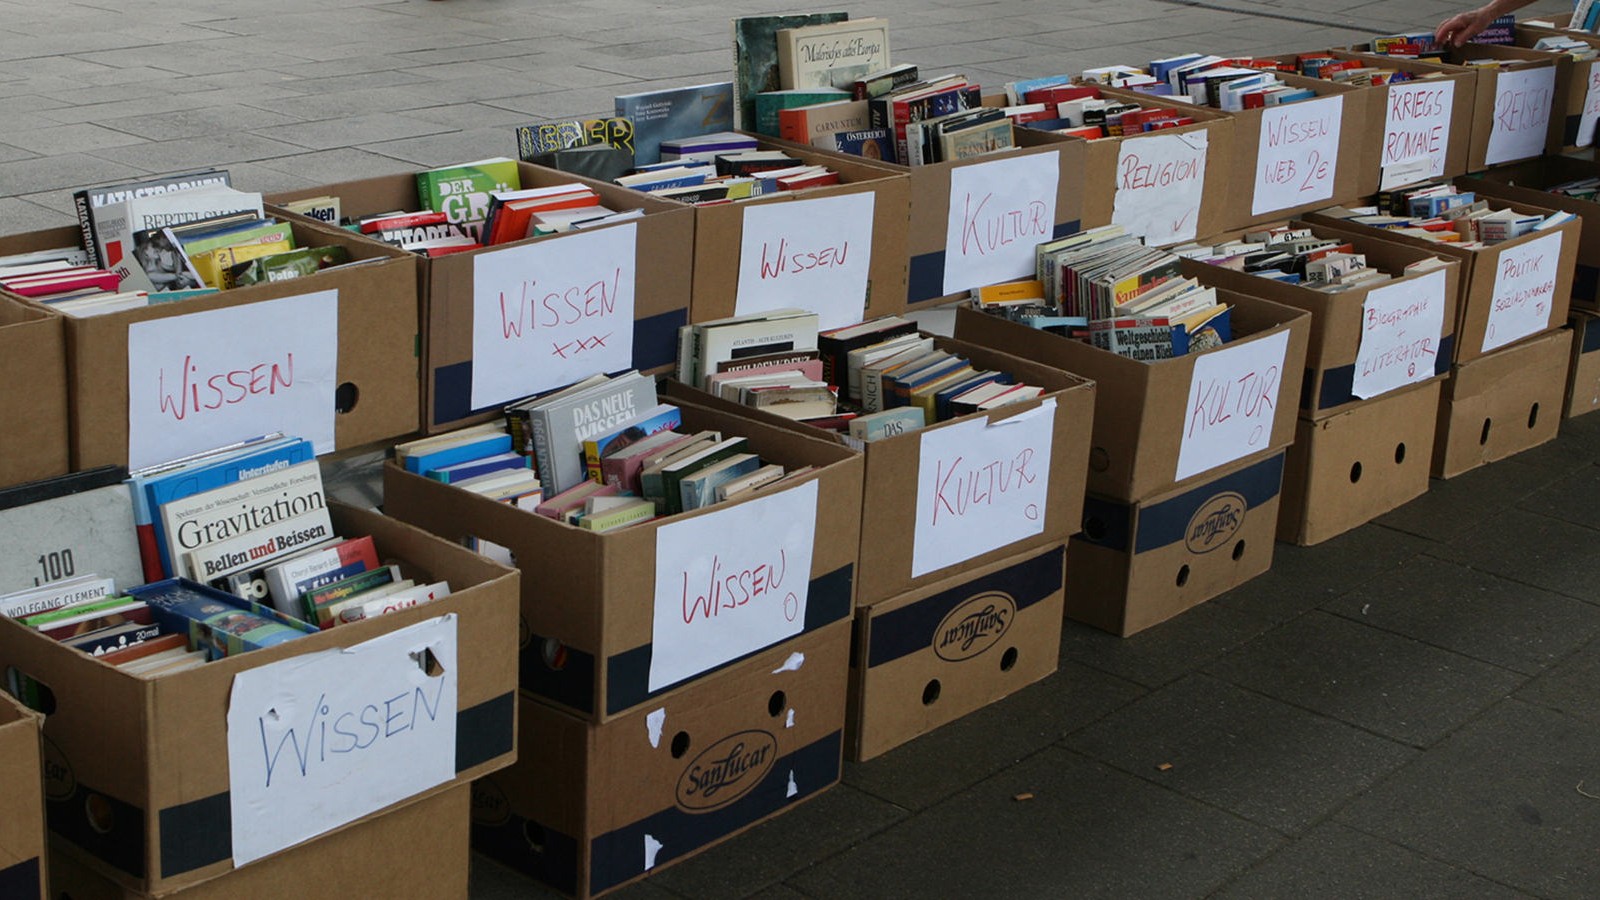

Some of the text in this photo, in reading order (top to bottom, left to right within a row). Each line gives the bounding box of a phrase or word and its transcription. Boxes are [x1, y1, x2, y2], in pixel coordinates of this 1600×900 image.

[1390, 89, 1443, 122] KRIEGS
[846, 128, 887, 141] ÖSTERREICH
[1386, 126, 1443, 165] ROMANE
[438, 179, 475, 196] DER
[1121, 150, 1205, 190] RELIGION
[962, 192, 1047, 255] KULTUR
[1502, 254, 1544, 281] POLITIK
[1115, 328, 1172, 347] Weltgeschichte
[1362, 337, 1436, 376] LITERATUR
[573, 388, 635, 427] DAS NEUE
[1188, 365, 1278, 439] KULTUR
[884, 421, 903, 436] DAS
[238, 459, 290, 481] Unterstufen
[932, 447, 1036, 527] KULTUR
[178, 491, 323, 550] Gravitation
[204, 524, 327, 576] Bellen und Beissen
[7, 586, 106, 618] WOLFGANG CLEMENT
[686, 742, 772, 798] SanLucar
